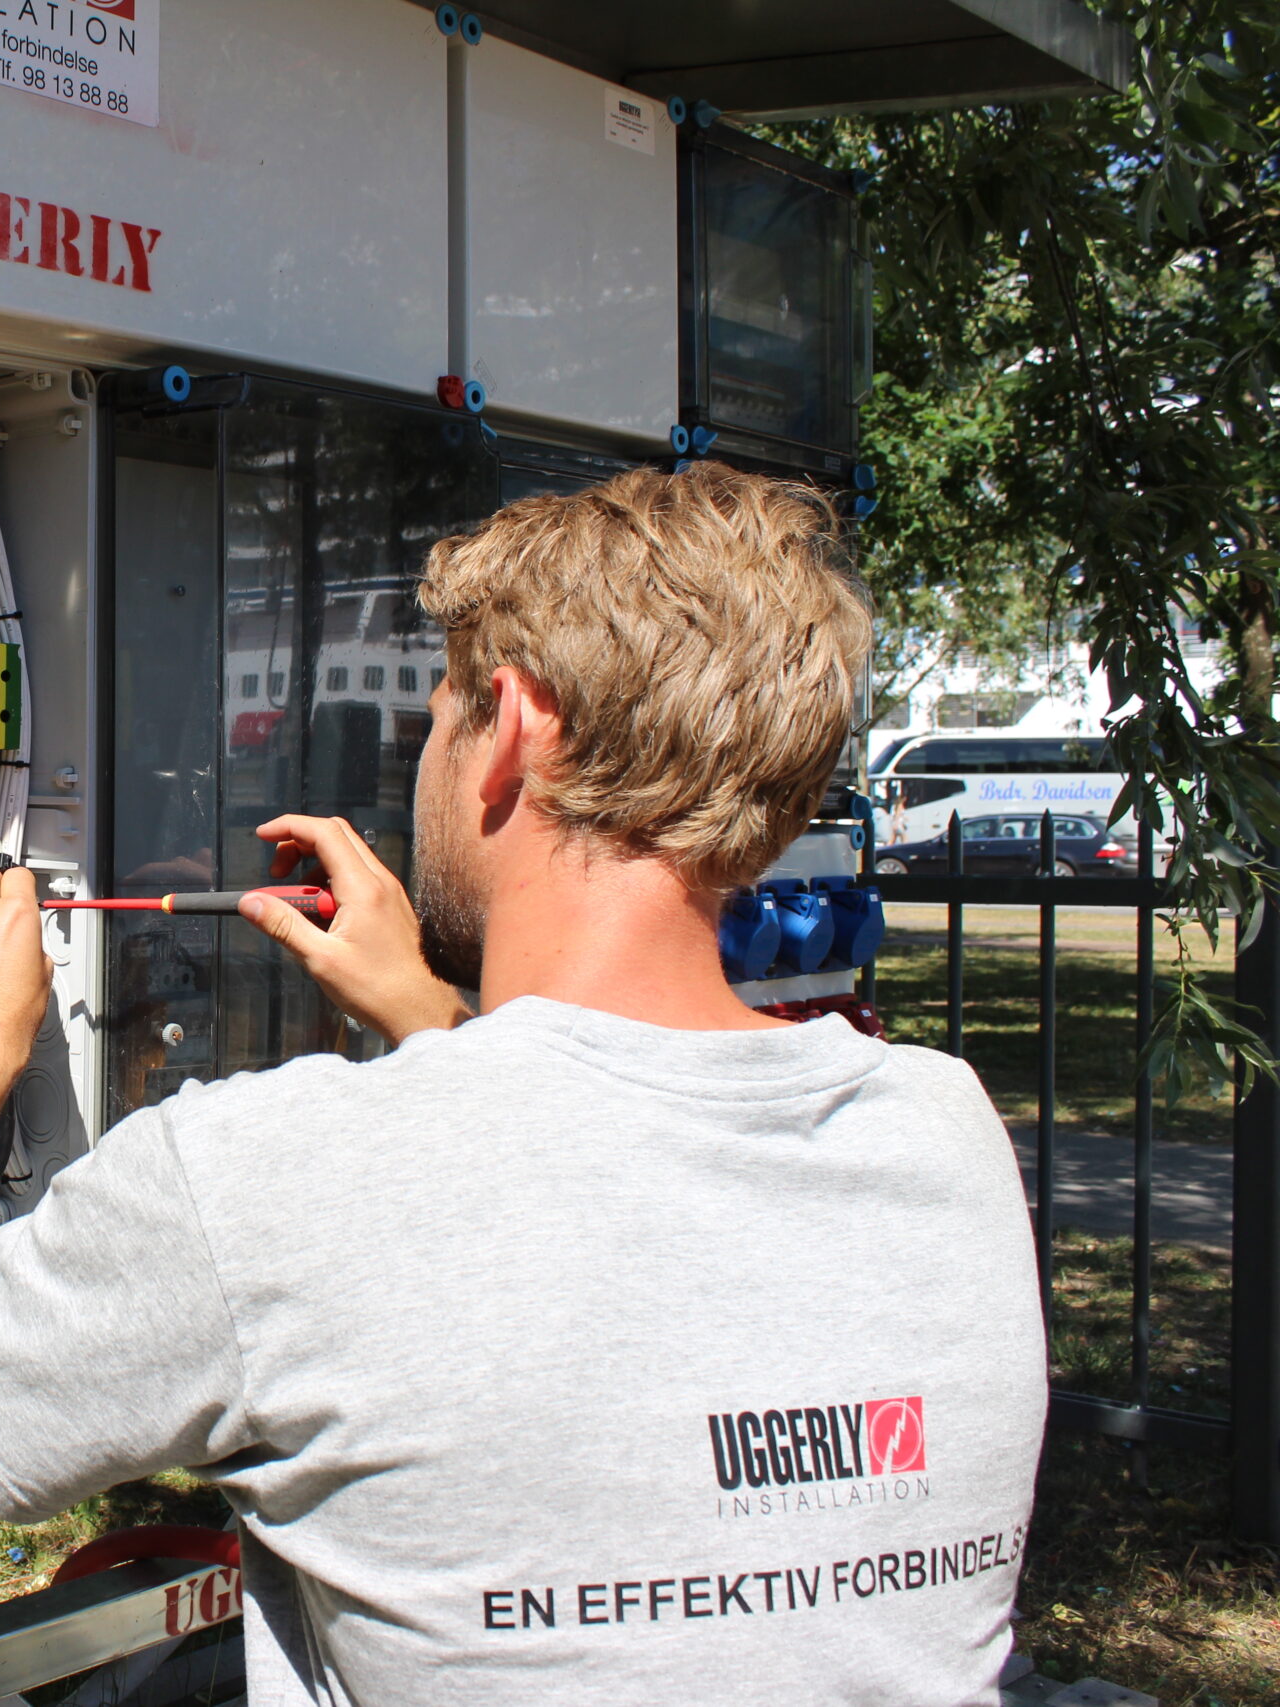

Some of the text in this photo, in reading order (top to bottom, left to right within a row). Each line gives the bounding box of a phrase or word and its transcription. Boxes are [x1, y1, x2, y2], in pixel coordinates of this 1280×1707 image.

[1, 29, 99, 76] forbindelse
[23, 66, 46, 90] 98
[53, 75, 74, 98] 13
[79, 83, 102, 107] 88
[107, 91, 129, 114] 88
[979, 779, 1113, 800] Brdr. Davidsen
[707, 1402, 865, 1491] UGGERLY
[717, 1477, 930, 1519] INSTALLATION
[483, 1525, 1026, 1630] EN EFFEKTIV FORBINDELS
[164, 1567, 244, 1637] UG
